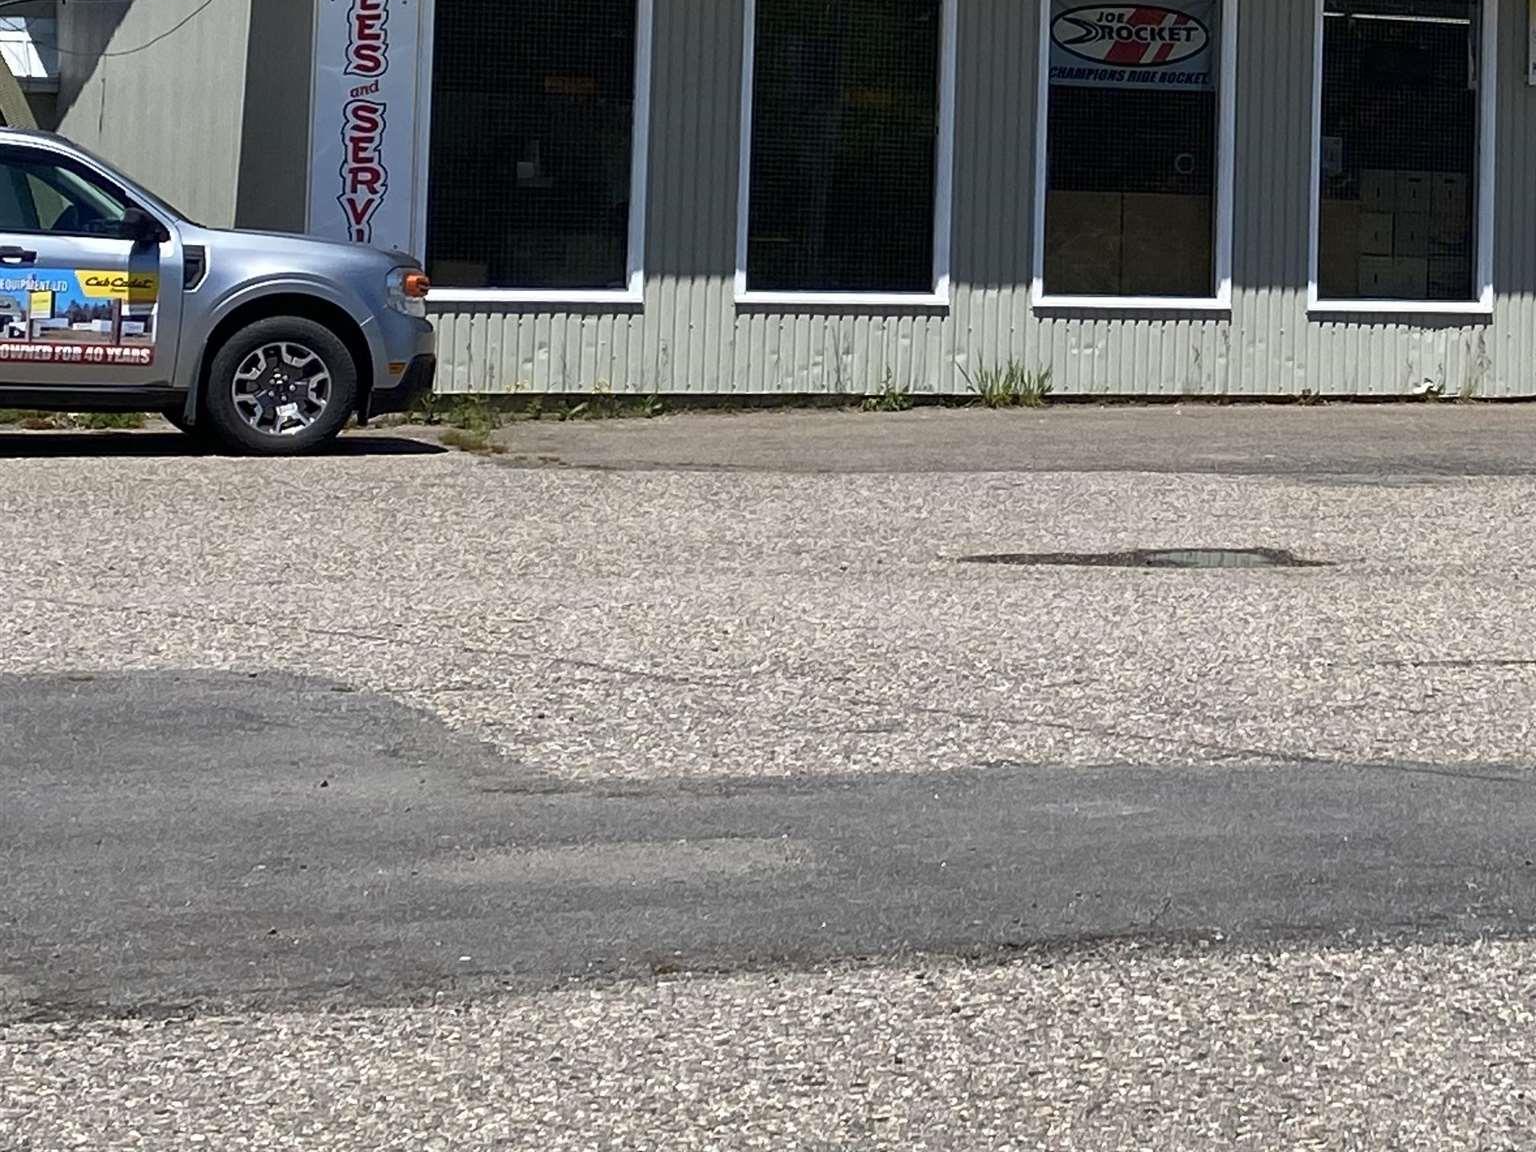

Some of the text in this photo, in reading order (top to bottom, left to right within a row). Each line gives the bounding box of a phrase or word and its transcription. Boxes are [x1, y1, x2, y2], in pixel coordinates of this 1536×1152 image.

[1097, 12, 1125, 23] JOE
[1098, 26, 1199, 42] ROCKET
[1050, 65, 1126, 82] CHAMPIONS
[1127, 70, 1158, 83] RIDE
[350, 80, 380, 99] and
[0, 344, 150, 363] OWNED FOR 40 YEARS
